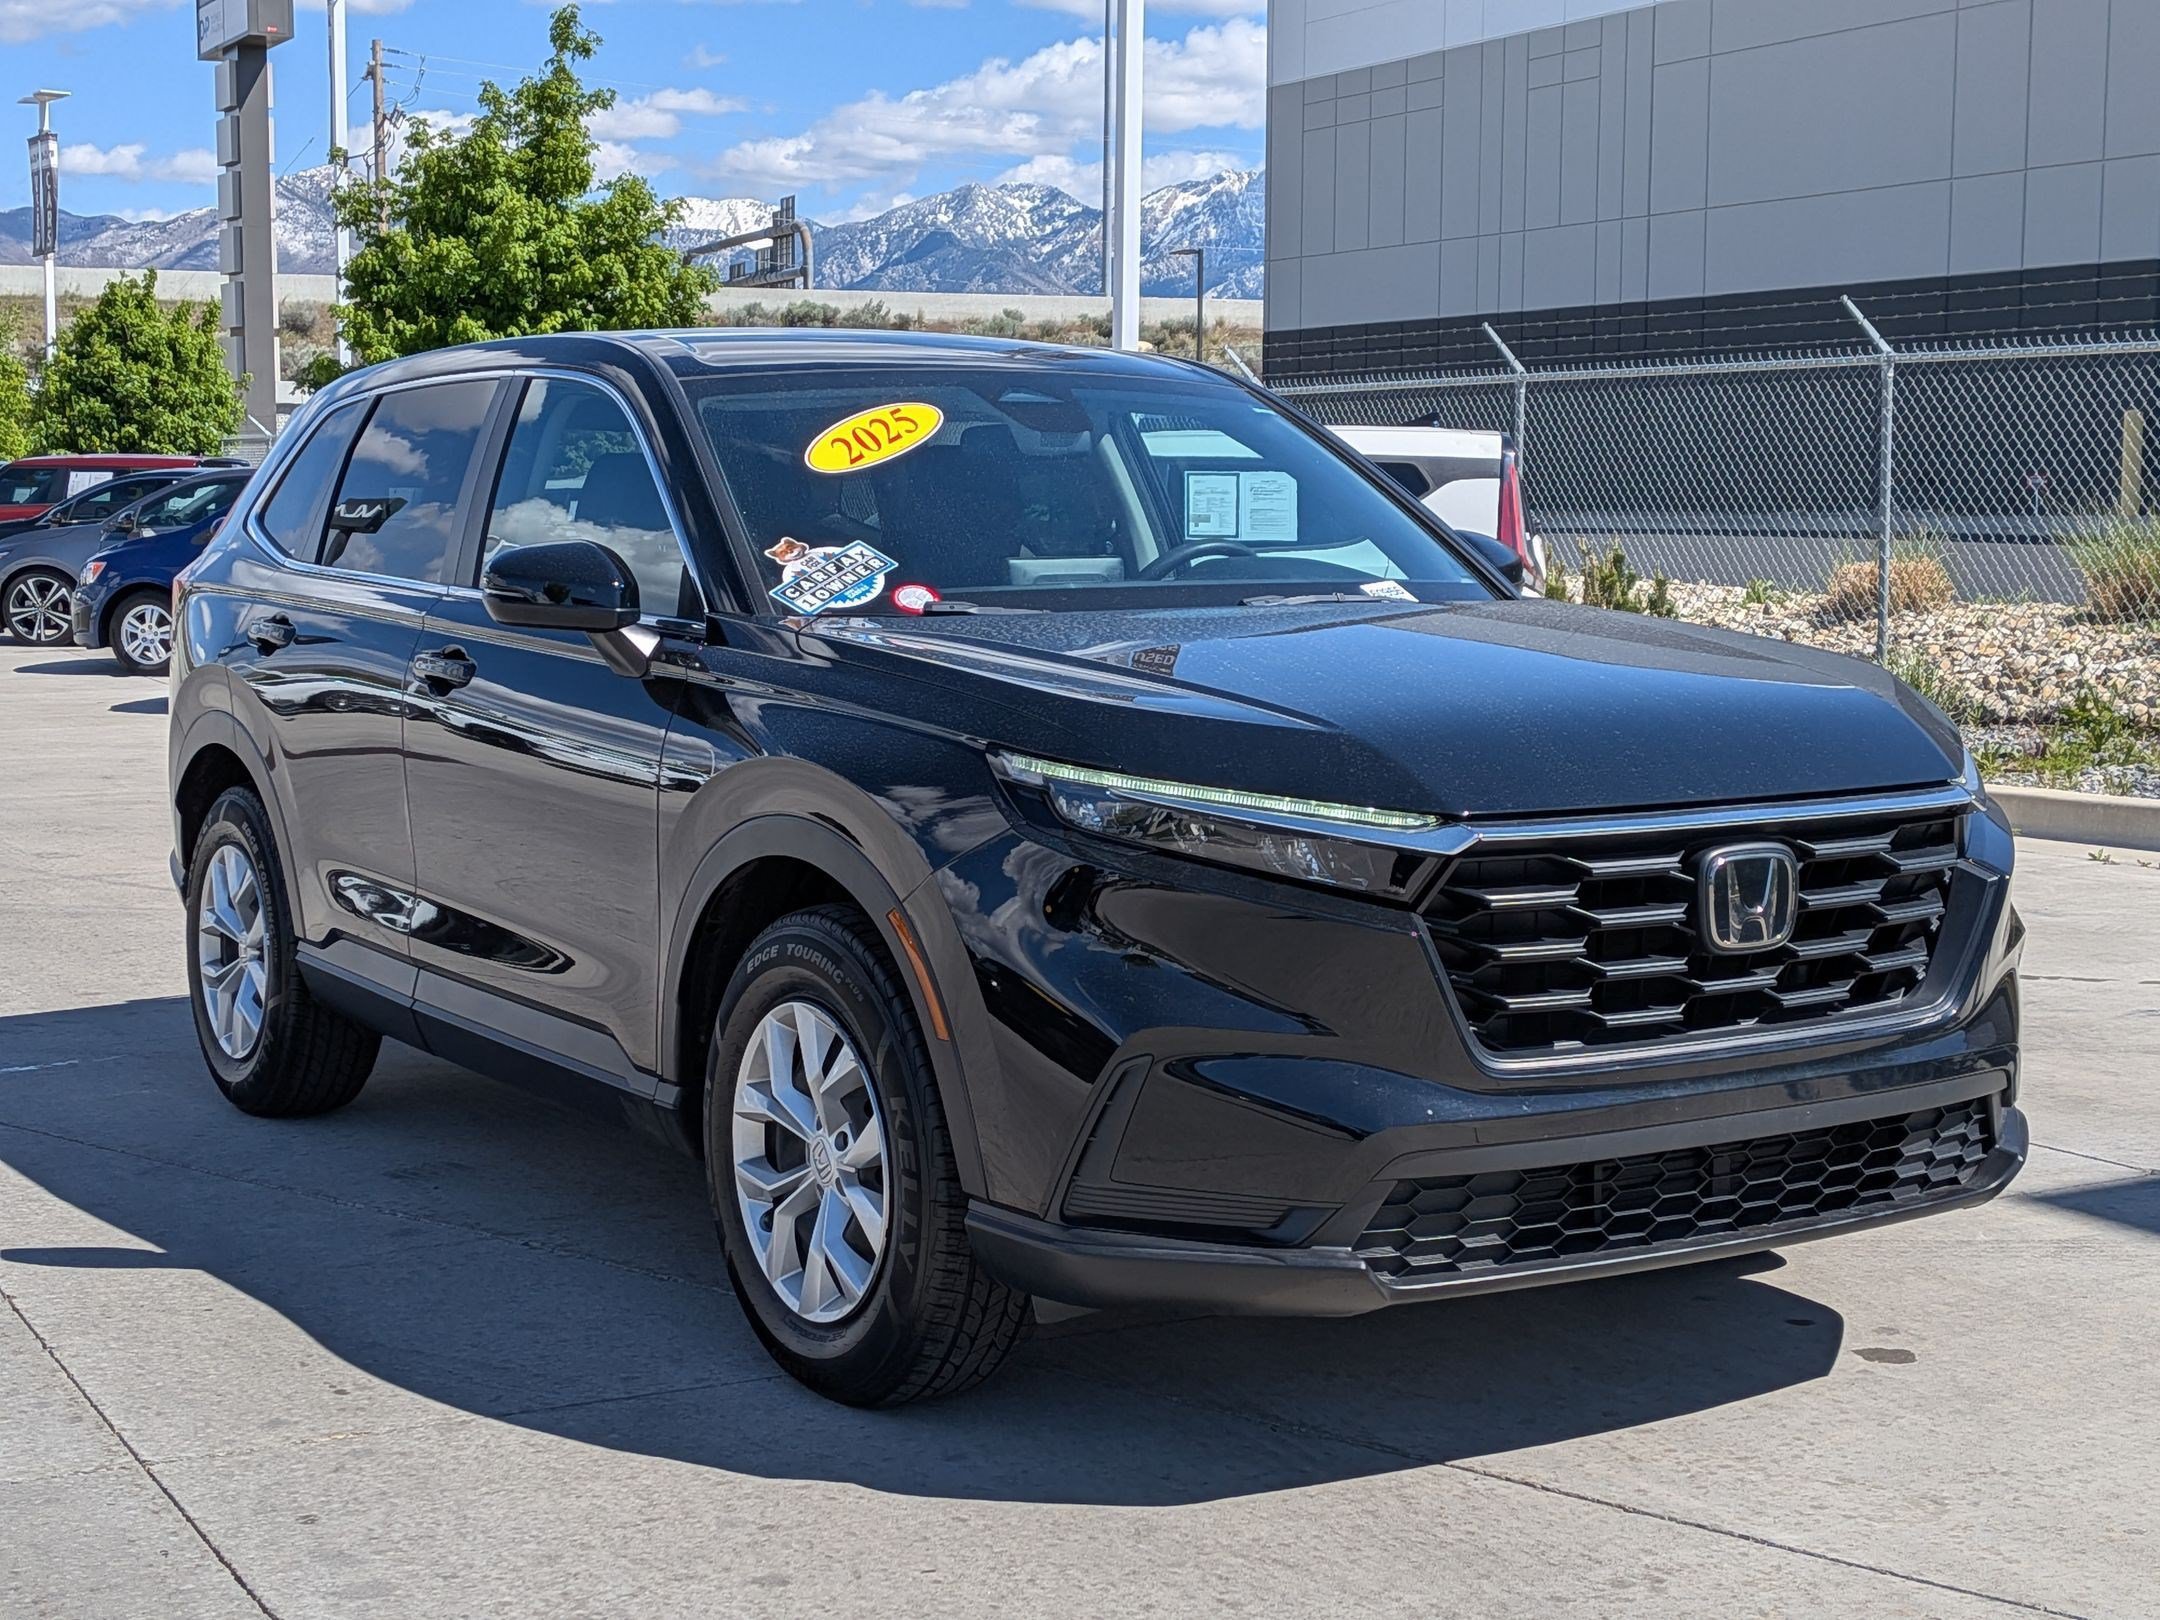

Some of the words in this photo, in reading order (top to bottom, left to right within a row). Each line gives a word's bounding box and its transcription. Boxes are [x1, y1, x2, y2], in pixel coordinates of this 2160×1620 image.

[831, 407, 919, 465] 2025
[785, 550, 870, 599] CARFAX
[815, 557, 885, 599] OWNER
[746, 944, 779, 974] EDGE
[786, 943, 845, 984] TOURING
[889, 1096, 918, 1273] KELLY
